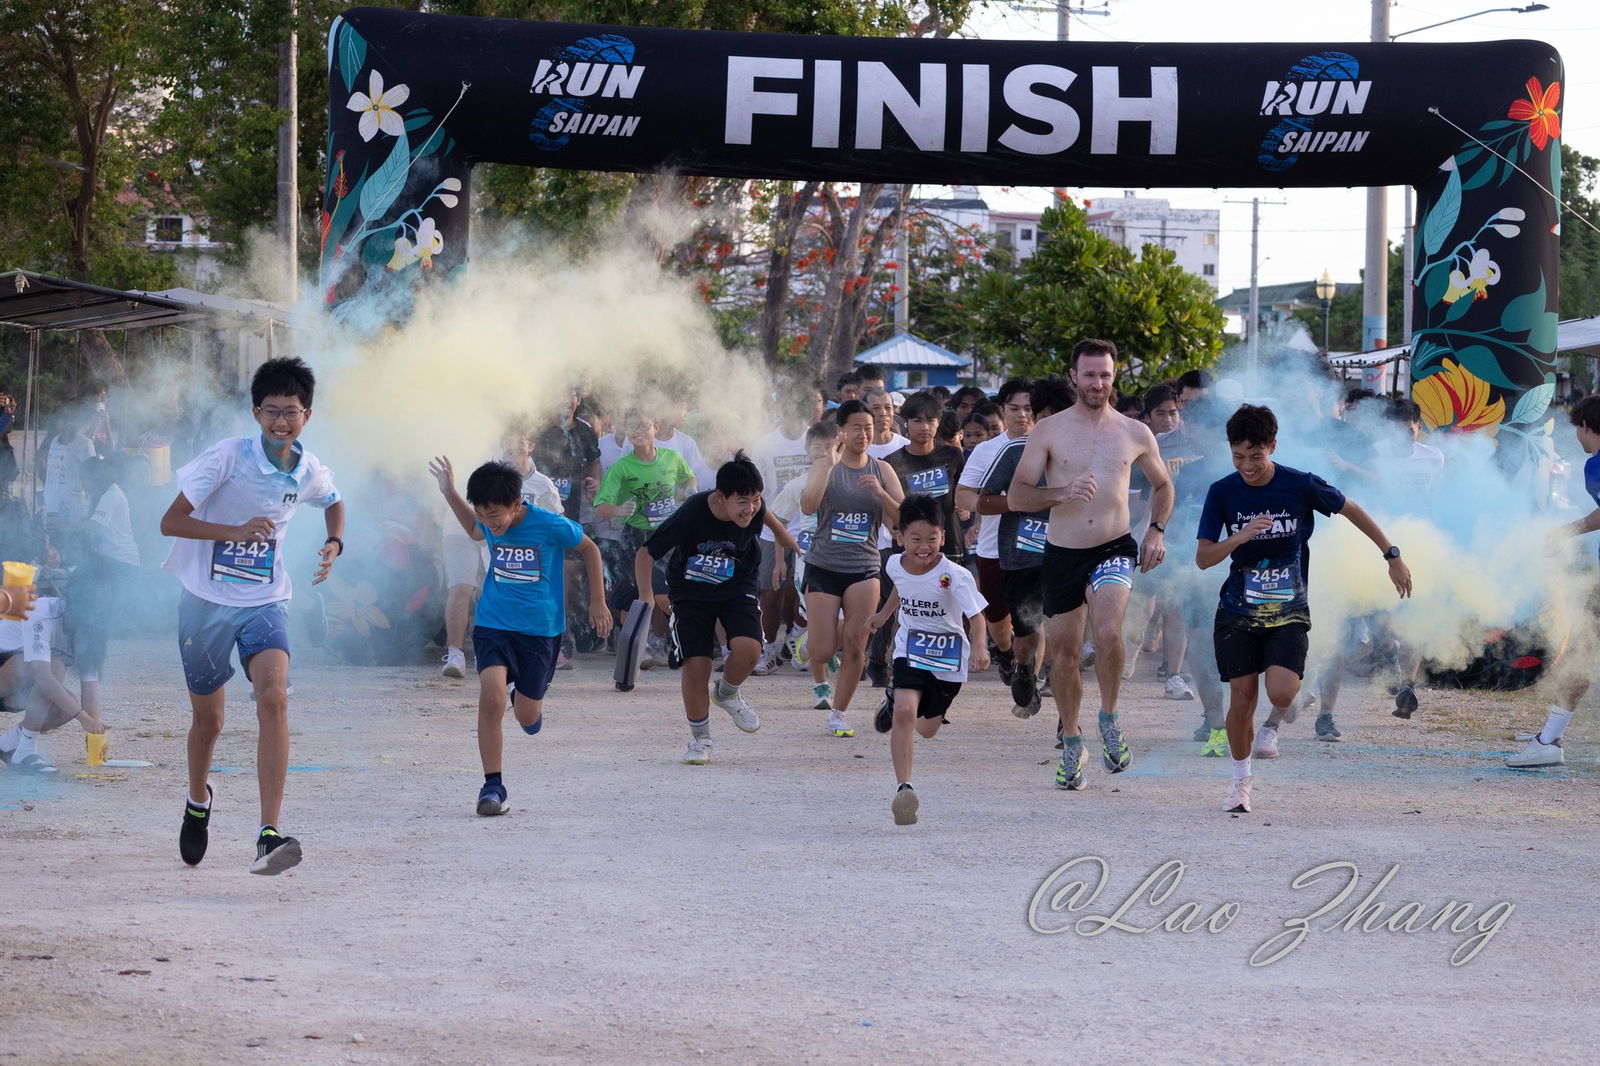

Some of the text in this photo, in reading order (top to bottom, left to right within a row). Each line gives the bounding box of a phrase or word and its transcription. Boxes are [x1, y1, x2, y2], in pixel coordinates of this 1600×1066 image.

[529, 59, 646, 99] RUN
[724, 55, 1179, 155] FINISH
[1260, 80, 1373, 117] RUN
[549, 111, 642, 138] SAIPAN
[1277, 131, 1371, 154] SAIPAN
[912, 468, 944, 485] 2773
[836, 512, 868, 524] 2483
[1237, 511, 1263, 521] Proje
[1024, 518, 1049, 533] 271
[1230, 518, 1298, 535] SAN
[222, 540, 270, 557] 2542
[496, 547, 535, 562] 2788
[695, 553, 729, 569] 2551
[1094, 557, 1130, 574] 2443
[1251, 567, 1290, 583] 2454
[915, 632, 956, 649] 2701
